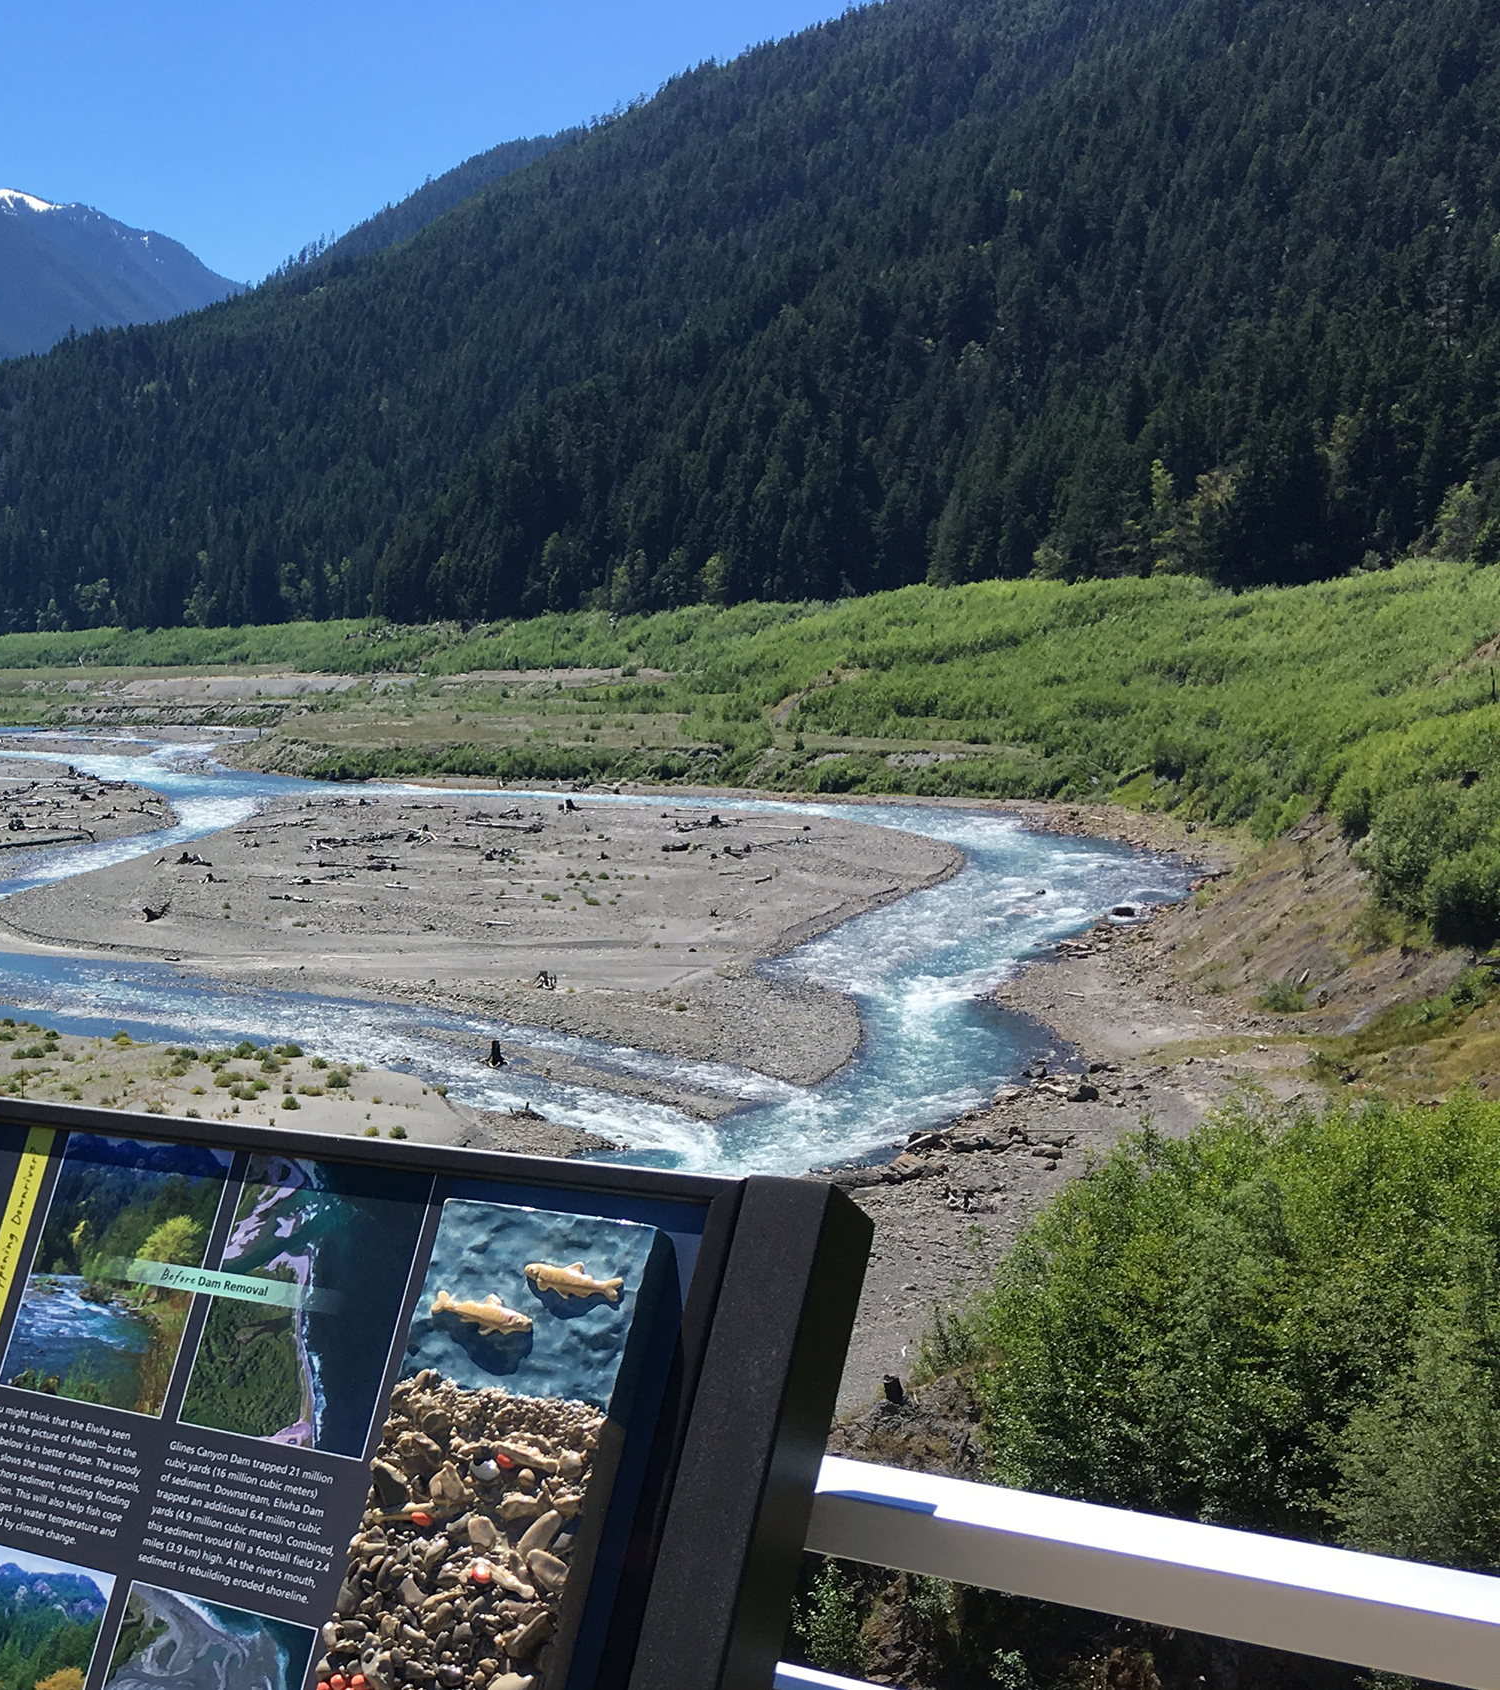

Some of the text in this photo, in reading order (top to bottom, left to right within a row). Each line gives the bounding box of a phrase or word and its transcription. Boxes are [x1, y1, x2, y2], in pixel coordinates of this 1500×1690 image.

[10, 1146, 37, 1226] Downriver?
[160, 1267, 269, 1297] Before Dam Removal
[5, 1407, 29, 1418] might
[30, 1411, 50, 1423] think
[52, 1416, 69, 1427] that
[70, 1419, 84, 1430] the
[85, 1422, 110, 1436] Elwha
[112, 1430, 130, 1440] seen
[9, 1422, 16, 1431] is
[17, 1424, 30, 1435] the
[31, 1428, 59, 1441] picture
[61, 1434, 71, 1443] of
[123, 1448, 137, 1458] the
[0, 1436, 24, 1449] below
[24, 1442, 31, 1451] is
[32, 1444, 40, 1453] in
[42, 1445, 67, 1458] better
[68, 1452, 93, 1465] shape.
[96, 1457, 111, 1469] The
[113, 1463, 141, 1477] woody
[0, 1452, 21, 1465] slows
[23, 1458, 36, 1468] the
[38, 1463, 61, 1475] water,
[64, 1469, 92, 1481] creates
[93, 1474, 115, 1488] deep
[115, 1481, 140, 1493] pools,
[170, 1441, 333, 1484] Glines Canyon Dam trapped 21 million
[18, 1474, 55, 1490] sediment,
[58, 1484, 93, 1500] reducing
[95, 1490, 130, 1509] flooding
[160, 1473, 324, 1517] of sediment. Downstream, Elwha Dam
[165, 1458, 318, 1499] cubic yards (16 million cubic meters)
[14, 1504, 22, 1514] in
[23, 1509, 47, 1519] water
[48, 1513, 98, 1533] temperature
[99, 1527, 117, 1537] and
[16, 1488, 31, 1500] This
[33, 1494, 48, 1503] will
[48, 1497, 64, 1508] also
[66, 1500, 84, 1514] help
[86, 1504, 101, 1516] fish
[102, 1511, 122, 1522] cope
[156, 1489, 321, 1535] trapped an additional 6.4 million cubic
[4, 1518, 15, 1530] by
[15, 1522, 44, 1536] climate
[46, 1529, 76, 1545] change.
[147, 1520, 163, 1532] this
[164, 1526, 203, 1542] sediment
[205, 1536, 233, 1548] would
[234, 1540, 246, 1551] fill
[255, 1545, 291, 1563] football
[293, 1554, 314, 1568] field
[315, 1560, 329, 1572] 2.4
[150, 1506, 334, 1557] yards (4.9 million cubic meters). Combined,
[138, 1554, 309, 1604] sediment is rebuilding eroded shoreline.
[142, 1537, 316, 1588] miles (3.9 km) high. At the river's mouth,
